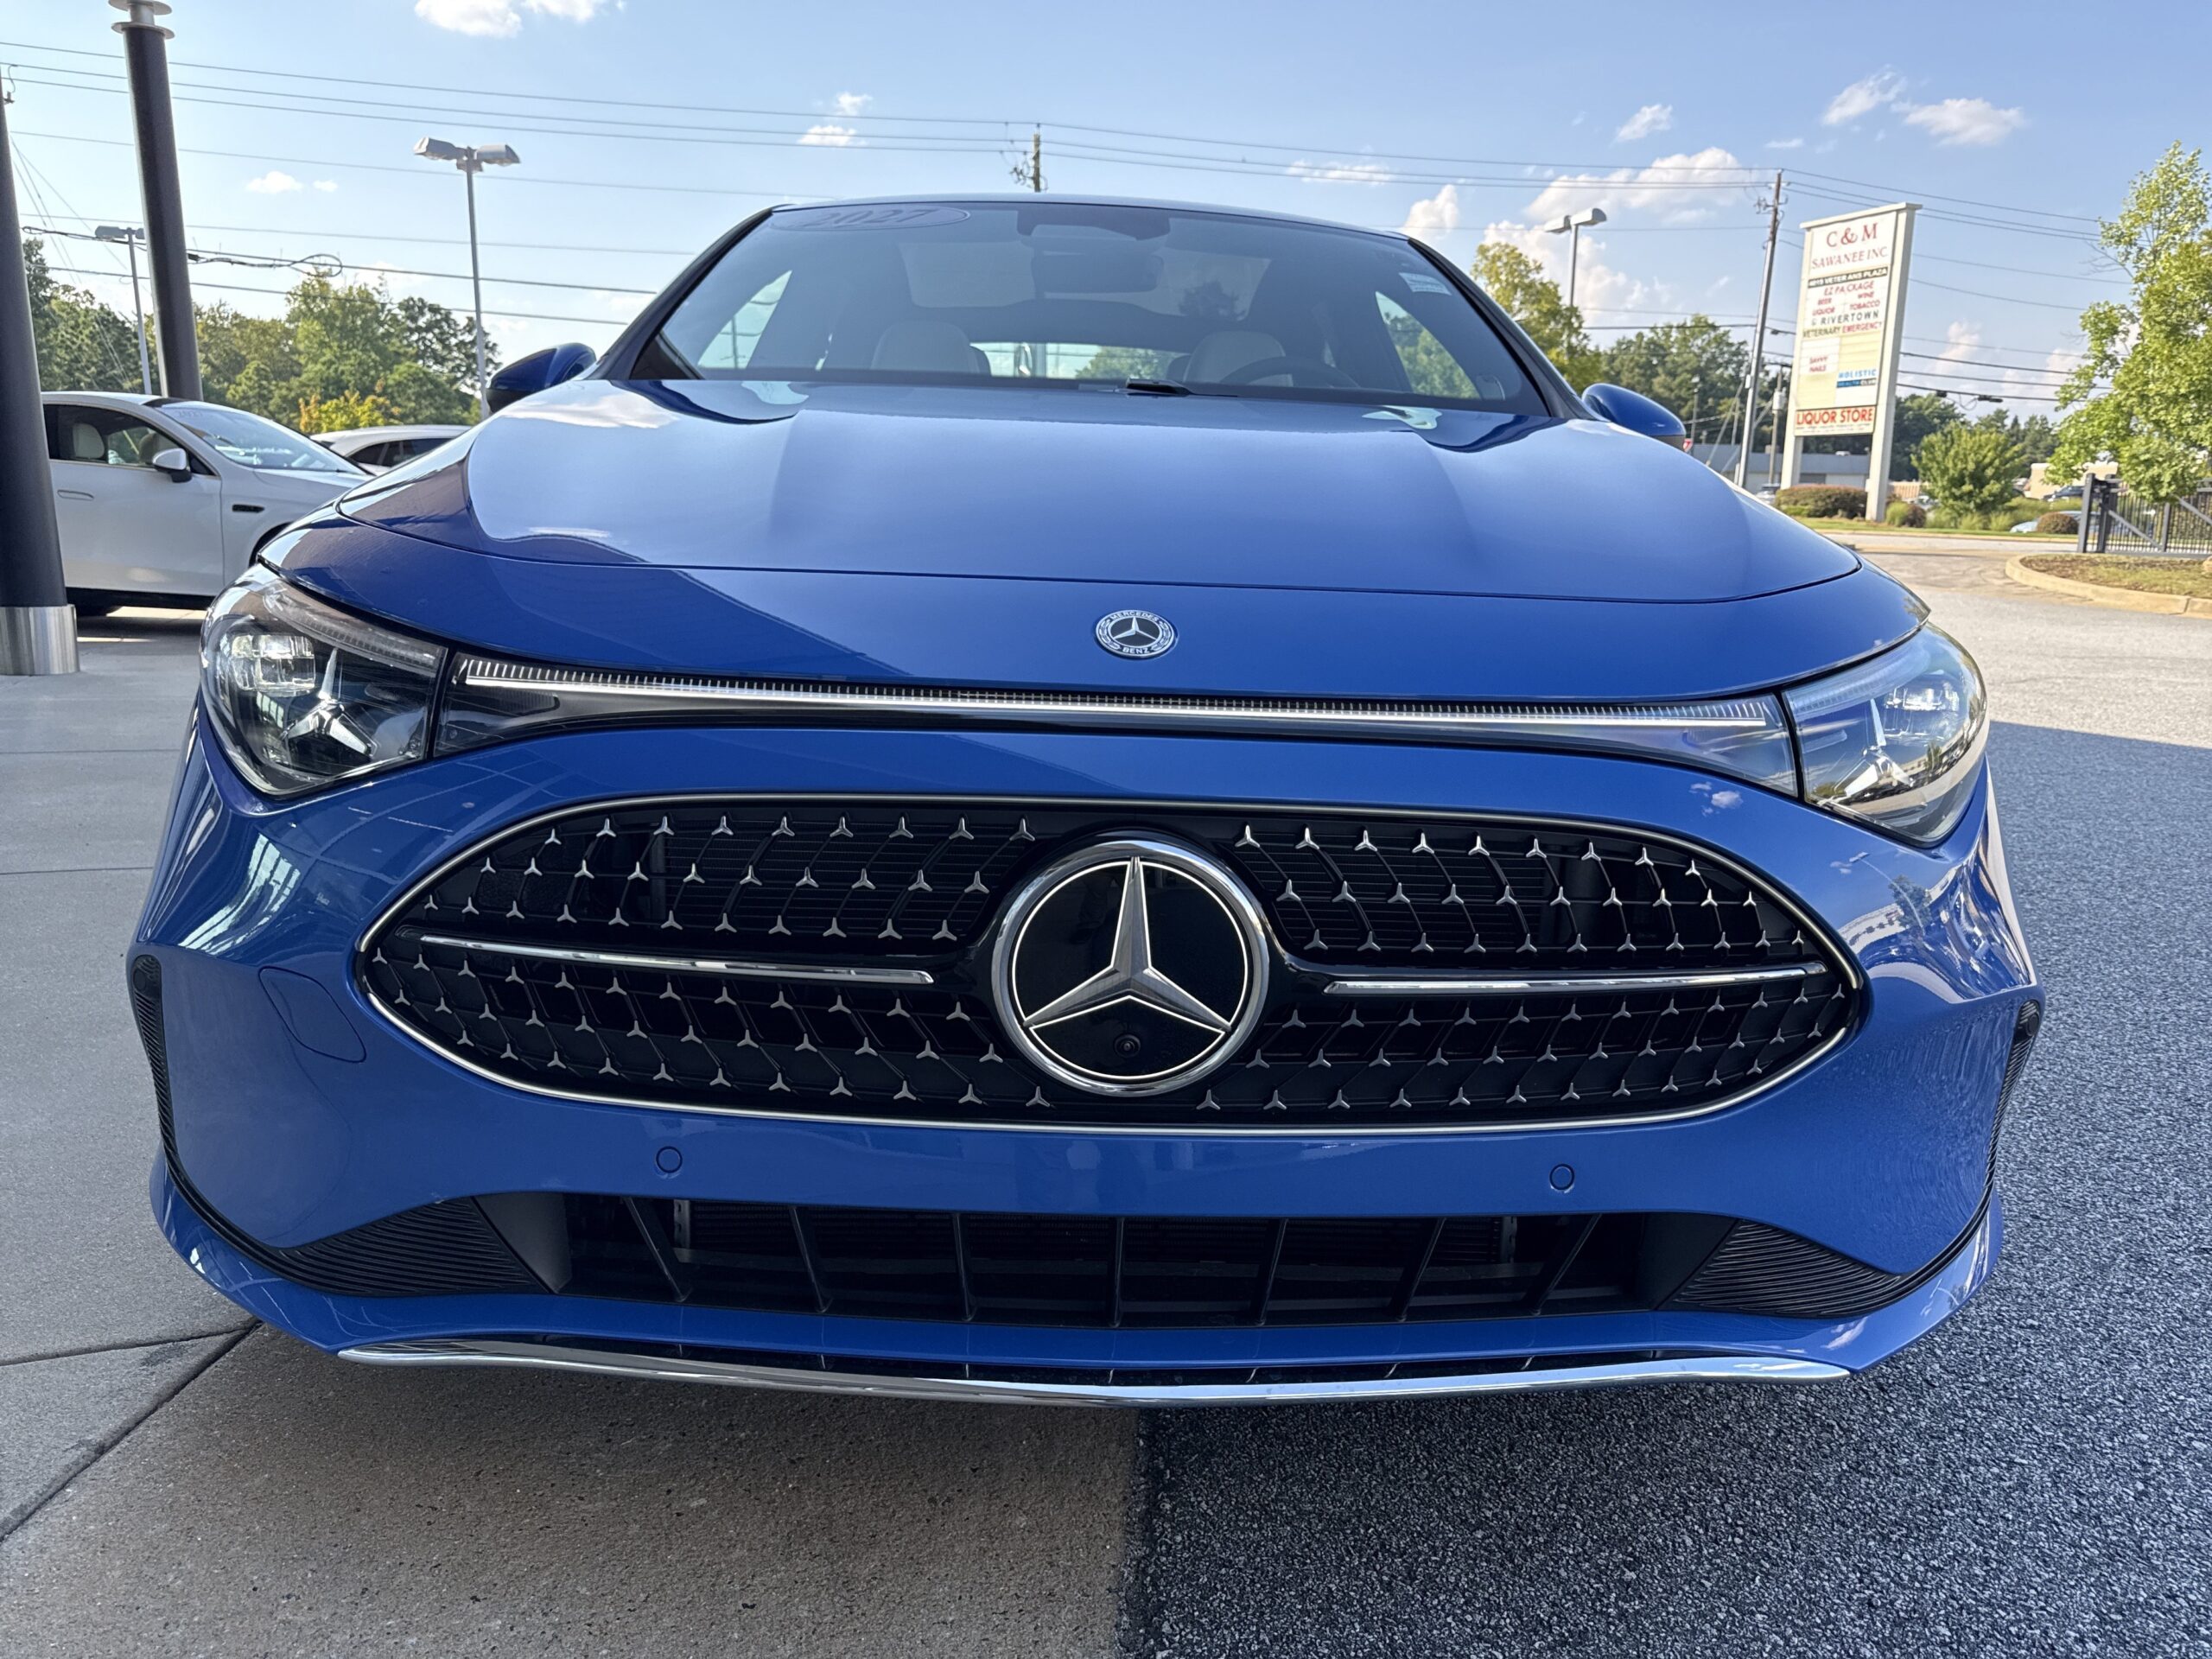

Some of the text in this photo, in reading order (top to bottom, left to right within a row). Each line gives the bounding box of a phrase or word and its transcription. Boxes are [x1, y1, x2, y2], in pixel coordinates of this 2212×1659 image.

[802, 208, 939, 227] 2027
[1827, 223, 1878, 247] C & M
[1867, 246, 1888, 258] INC
[1863, 268, 1887, 278] PLAZA
[1834, 280, 1875, 295] PACKAGE
[1812, 306, 1836, 316] LIQUOR
[1849, 299, 1880, 310] TOBACCO
[1820, 309, 1879, 326] RIVERTOWN
[1803, 321, 1882, 338] VETERINARY EMERGENCY
[1838, 369, 1877, 378] HOLISTIC
[1796, 408, 1873, 424] LIQUOR STORE
[1109, 610, 1160, 622] MERCEDES
